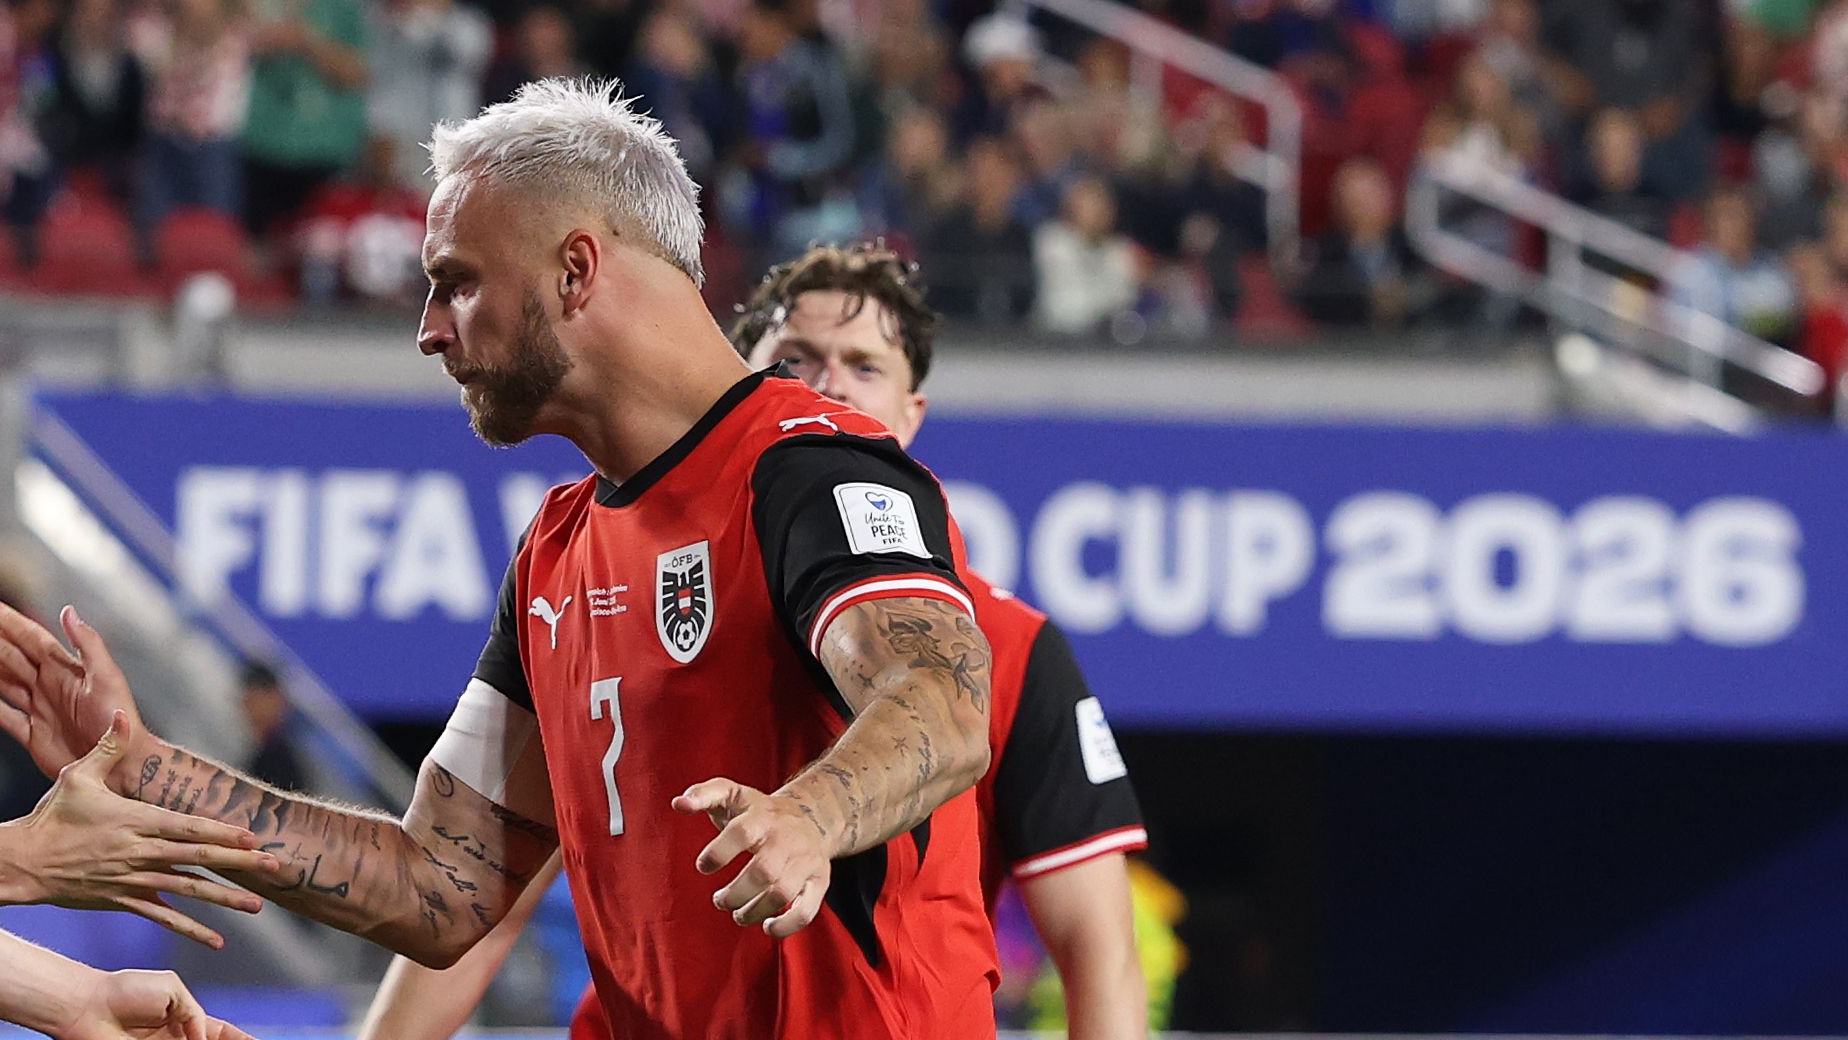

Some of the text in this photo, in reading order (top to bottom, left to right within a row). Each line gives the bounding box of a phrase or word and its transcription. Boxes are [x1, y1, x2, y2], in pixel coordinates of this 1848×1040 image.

[177, 466, 493, 620] FIFA
[871, 524, 908, 540] PEACE
[1030, 481, 1316, 636] CUP
[1321, 489, 1807, 647] 2026
[591, 677, 625, 837] 7
